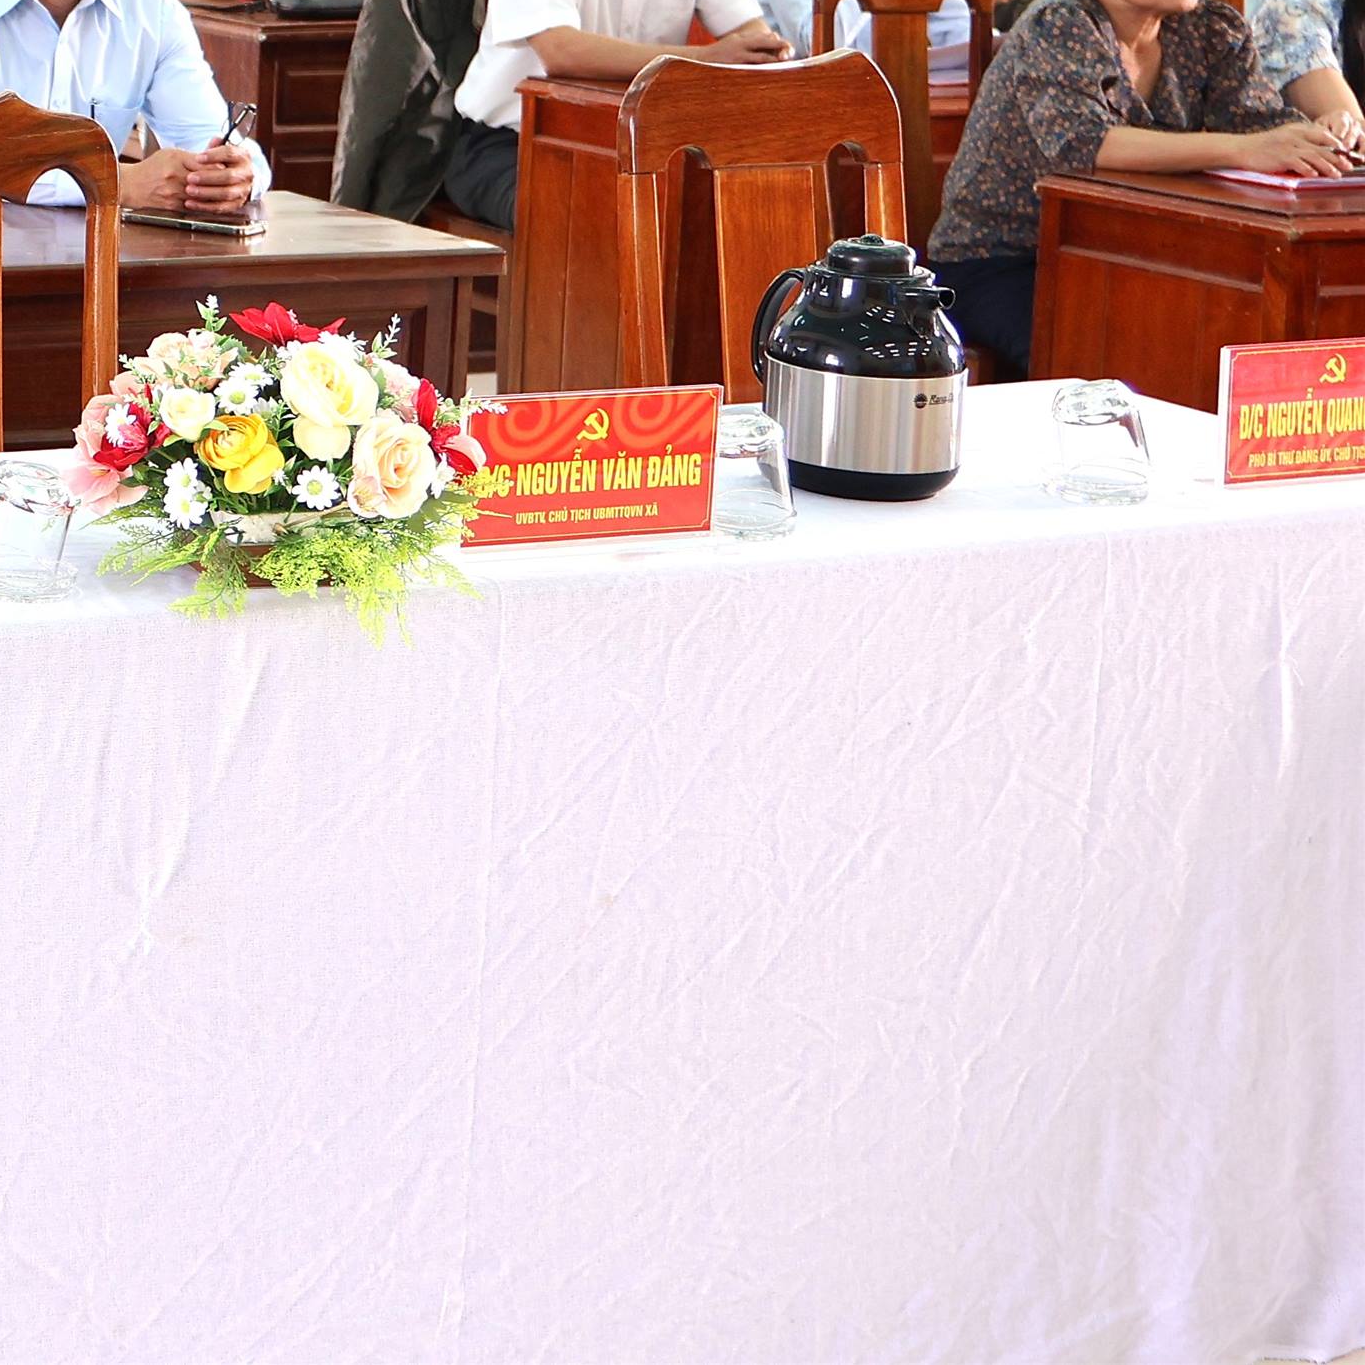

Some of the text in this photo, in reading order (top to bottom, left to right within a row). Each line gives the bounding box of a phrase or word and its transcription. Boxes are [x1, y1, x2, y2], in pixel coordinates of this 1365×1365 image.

[1239, 387, 1365, 441] Đ/C NGUYỄN QUAN
[516, 448, 596, 496] NGUYỄN
[602, 451, 643, 491] VĂN
[646, 444, 702, 488] ĐẢNG
[548, 506, 568, 522] CHỦ
[570, 507, 591, 524] TỊCH
[592, 504, 643, 520] UBMTTQVN
[645, 502, 658, 516] XÃ
